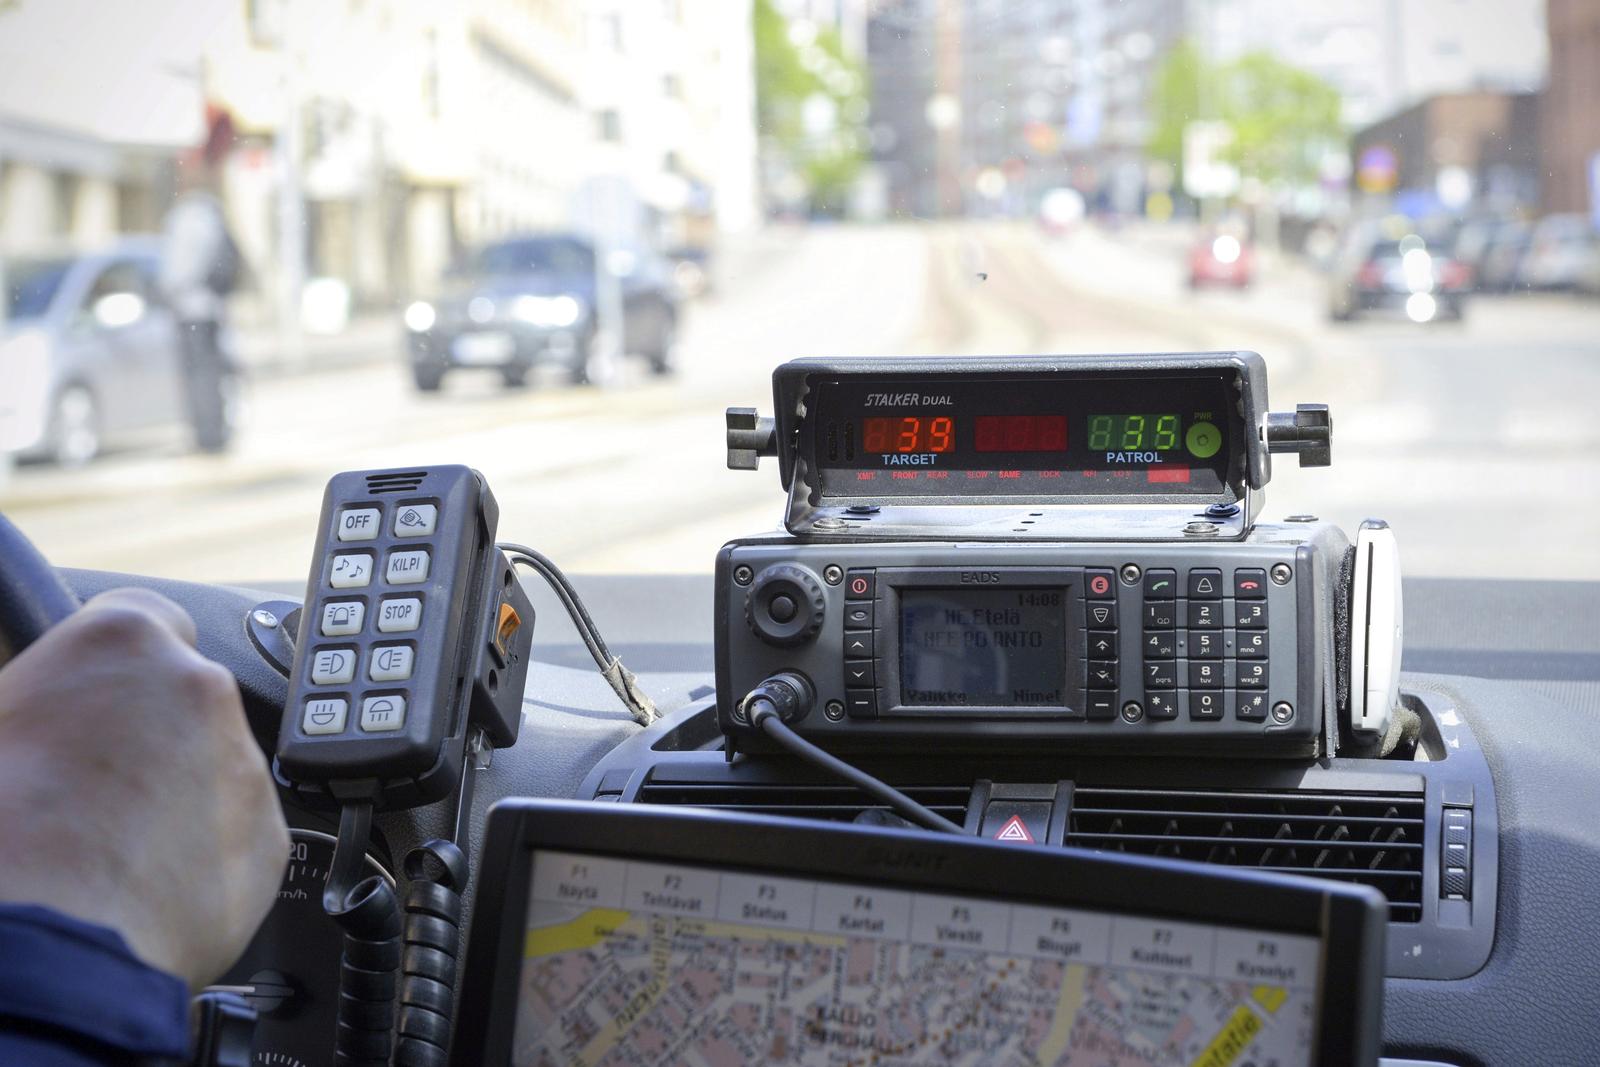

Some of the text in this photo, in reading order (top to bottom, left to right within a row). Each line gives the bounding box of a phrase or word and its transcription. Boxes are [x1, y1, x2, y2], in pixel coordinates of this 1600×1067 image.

[864, 393, 953, 407] STALKER DUAL
[899, 417, 952, 451] 39
[1124, 415, 1176, 450] 35
[881, 453, 938, 465] TARGET
[1106, 451, 1163, 463] PATROL
[891, 470, 919, 479] FRONT
[926, 470, 949, 479] REAR
[967, 470, 988, 479] SLOW
[998, 470, 1022, 479] SAME
[345, 515, 371, 529] OFF
[391, 557, 420, 572] KILPI
[960, 571, 1000, 584] EADS
[1017, 593, 1060, 607] 14:08
[384, 604, 412, 620] STOP
[1200, 606, 1210, 616] 2
[1252, 606, 1261, 616] 3
[1150, 636, 1159, 646] 4
[1200, 636, 1210, 645] 5
[1252, 636, 1262, 646] 6
[1160, 647, 1171, 655] ghi
[1150, 666, 1159, 676] 7
[1201, 666, 1210, 676] 8
[1253, 666, 1262, 676] 9
[1013, 689, 1062, 702] Nimet
[1201, 696, 1211, 705] 0
[742, 903, 789, 922] Status
